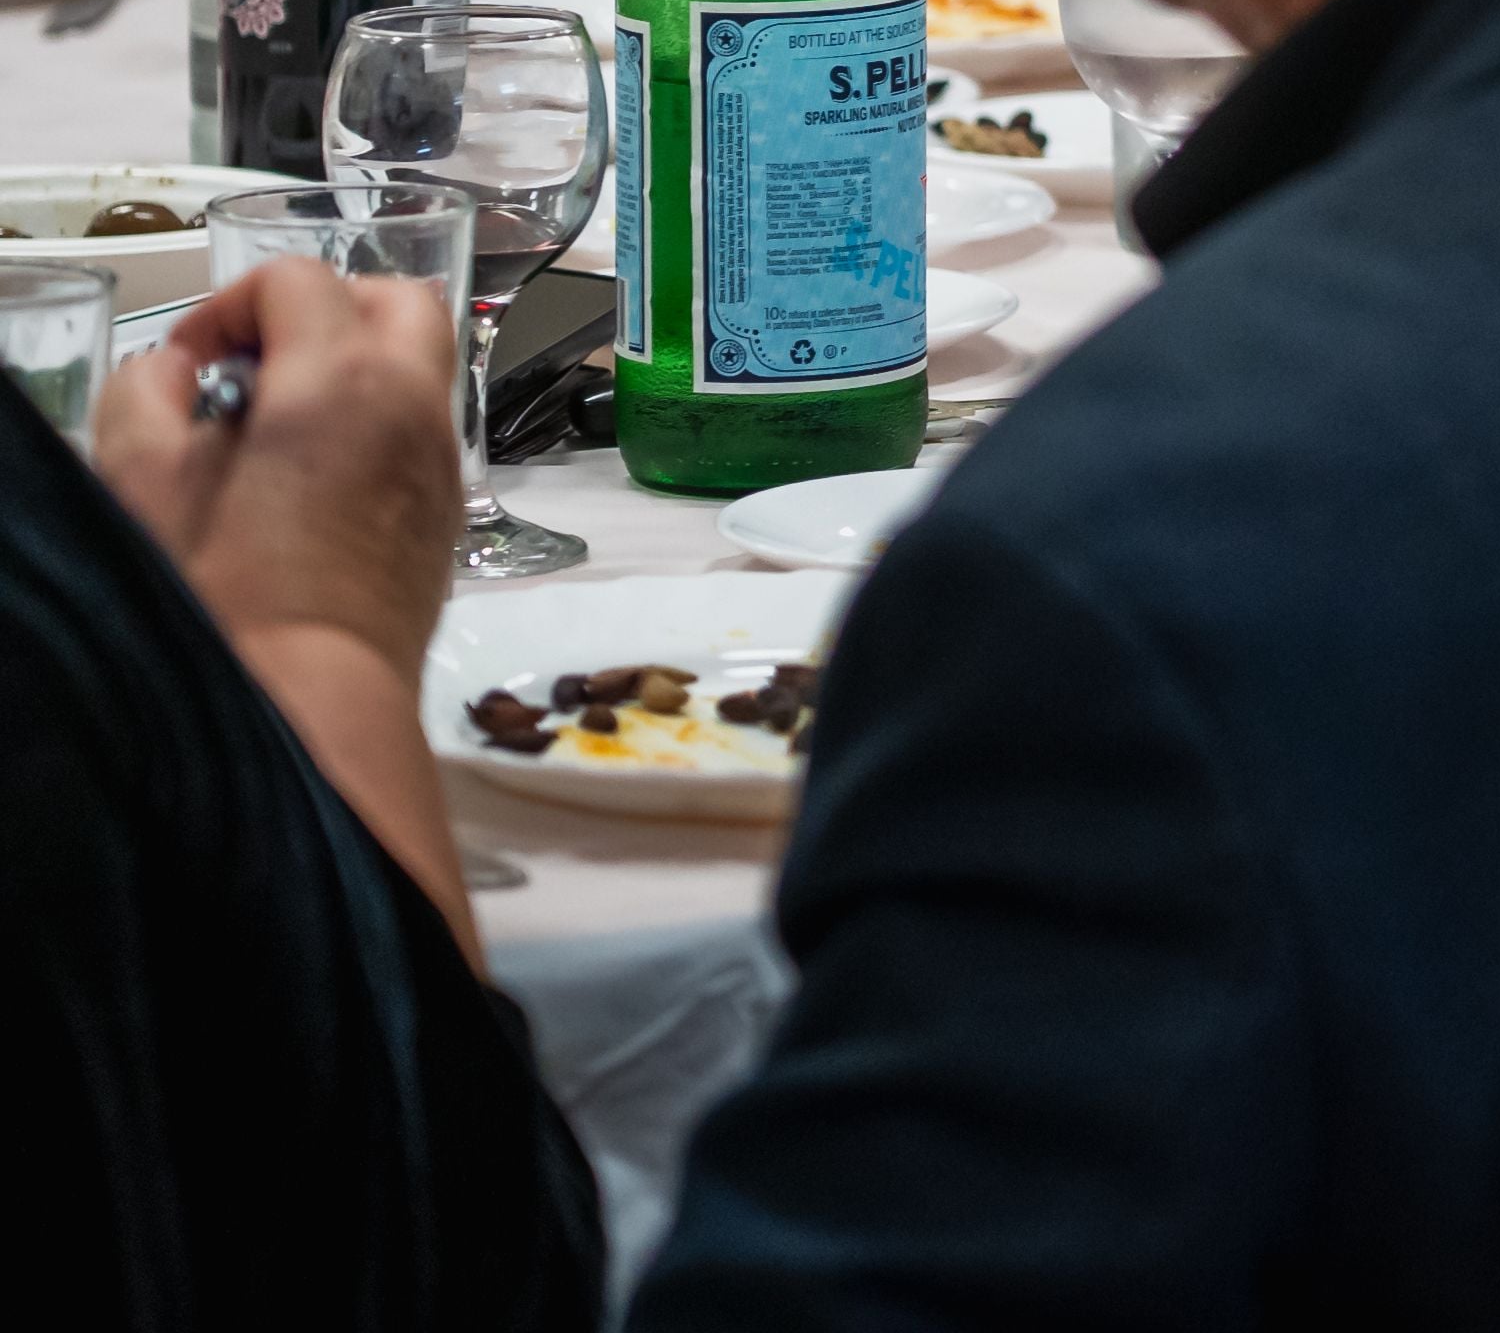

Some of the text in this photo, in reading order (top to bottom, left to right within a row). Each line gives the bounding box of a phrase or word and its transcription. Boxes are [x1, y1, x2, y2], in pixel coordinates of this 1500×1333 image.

[789, 32, 846, 49] BOTTLED
[848, 30, 863, 45] AT
[862, 27, 884, 41] THE
[804, 106, 867, 126] SPARKLING
[869, 100, 907, 119] NATURAL
